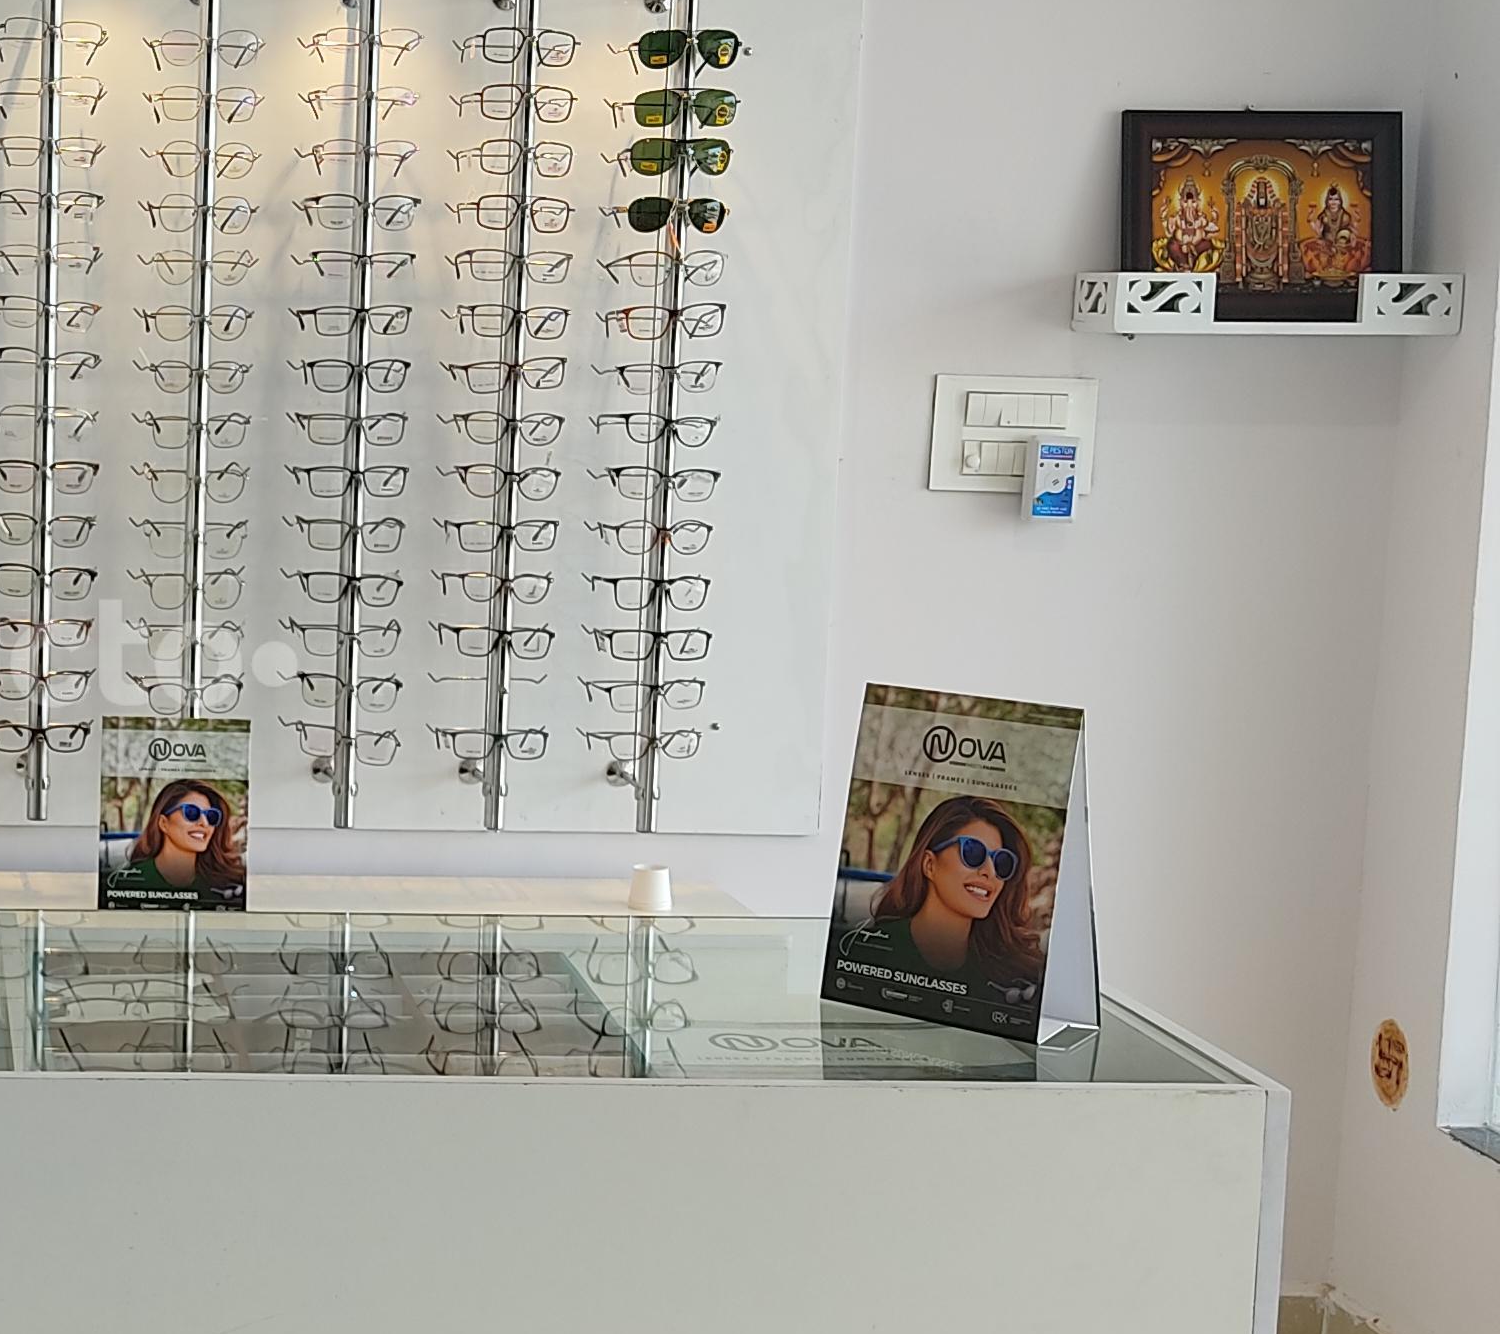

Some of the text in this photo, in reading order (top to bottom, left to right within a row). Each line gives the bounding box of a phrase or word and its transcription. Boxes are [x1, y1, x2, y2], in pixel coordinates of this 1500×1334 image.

[148, 738, 207, 761] NOVA
[923, 725, 1006, 763] NOVA
[937, 774, 964, 784] FRAMES
[972, 778, 1018, 791] SUNGLASSES
[107, 890, 198, 900] POWERED SUNGLASSES
[837, 959, 967, 995] POWERED SUNGLASSES
